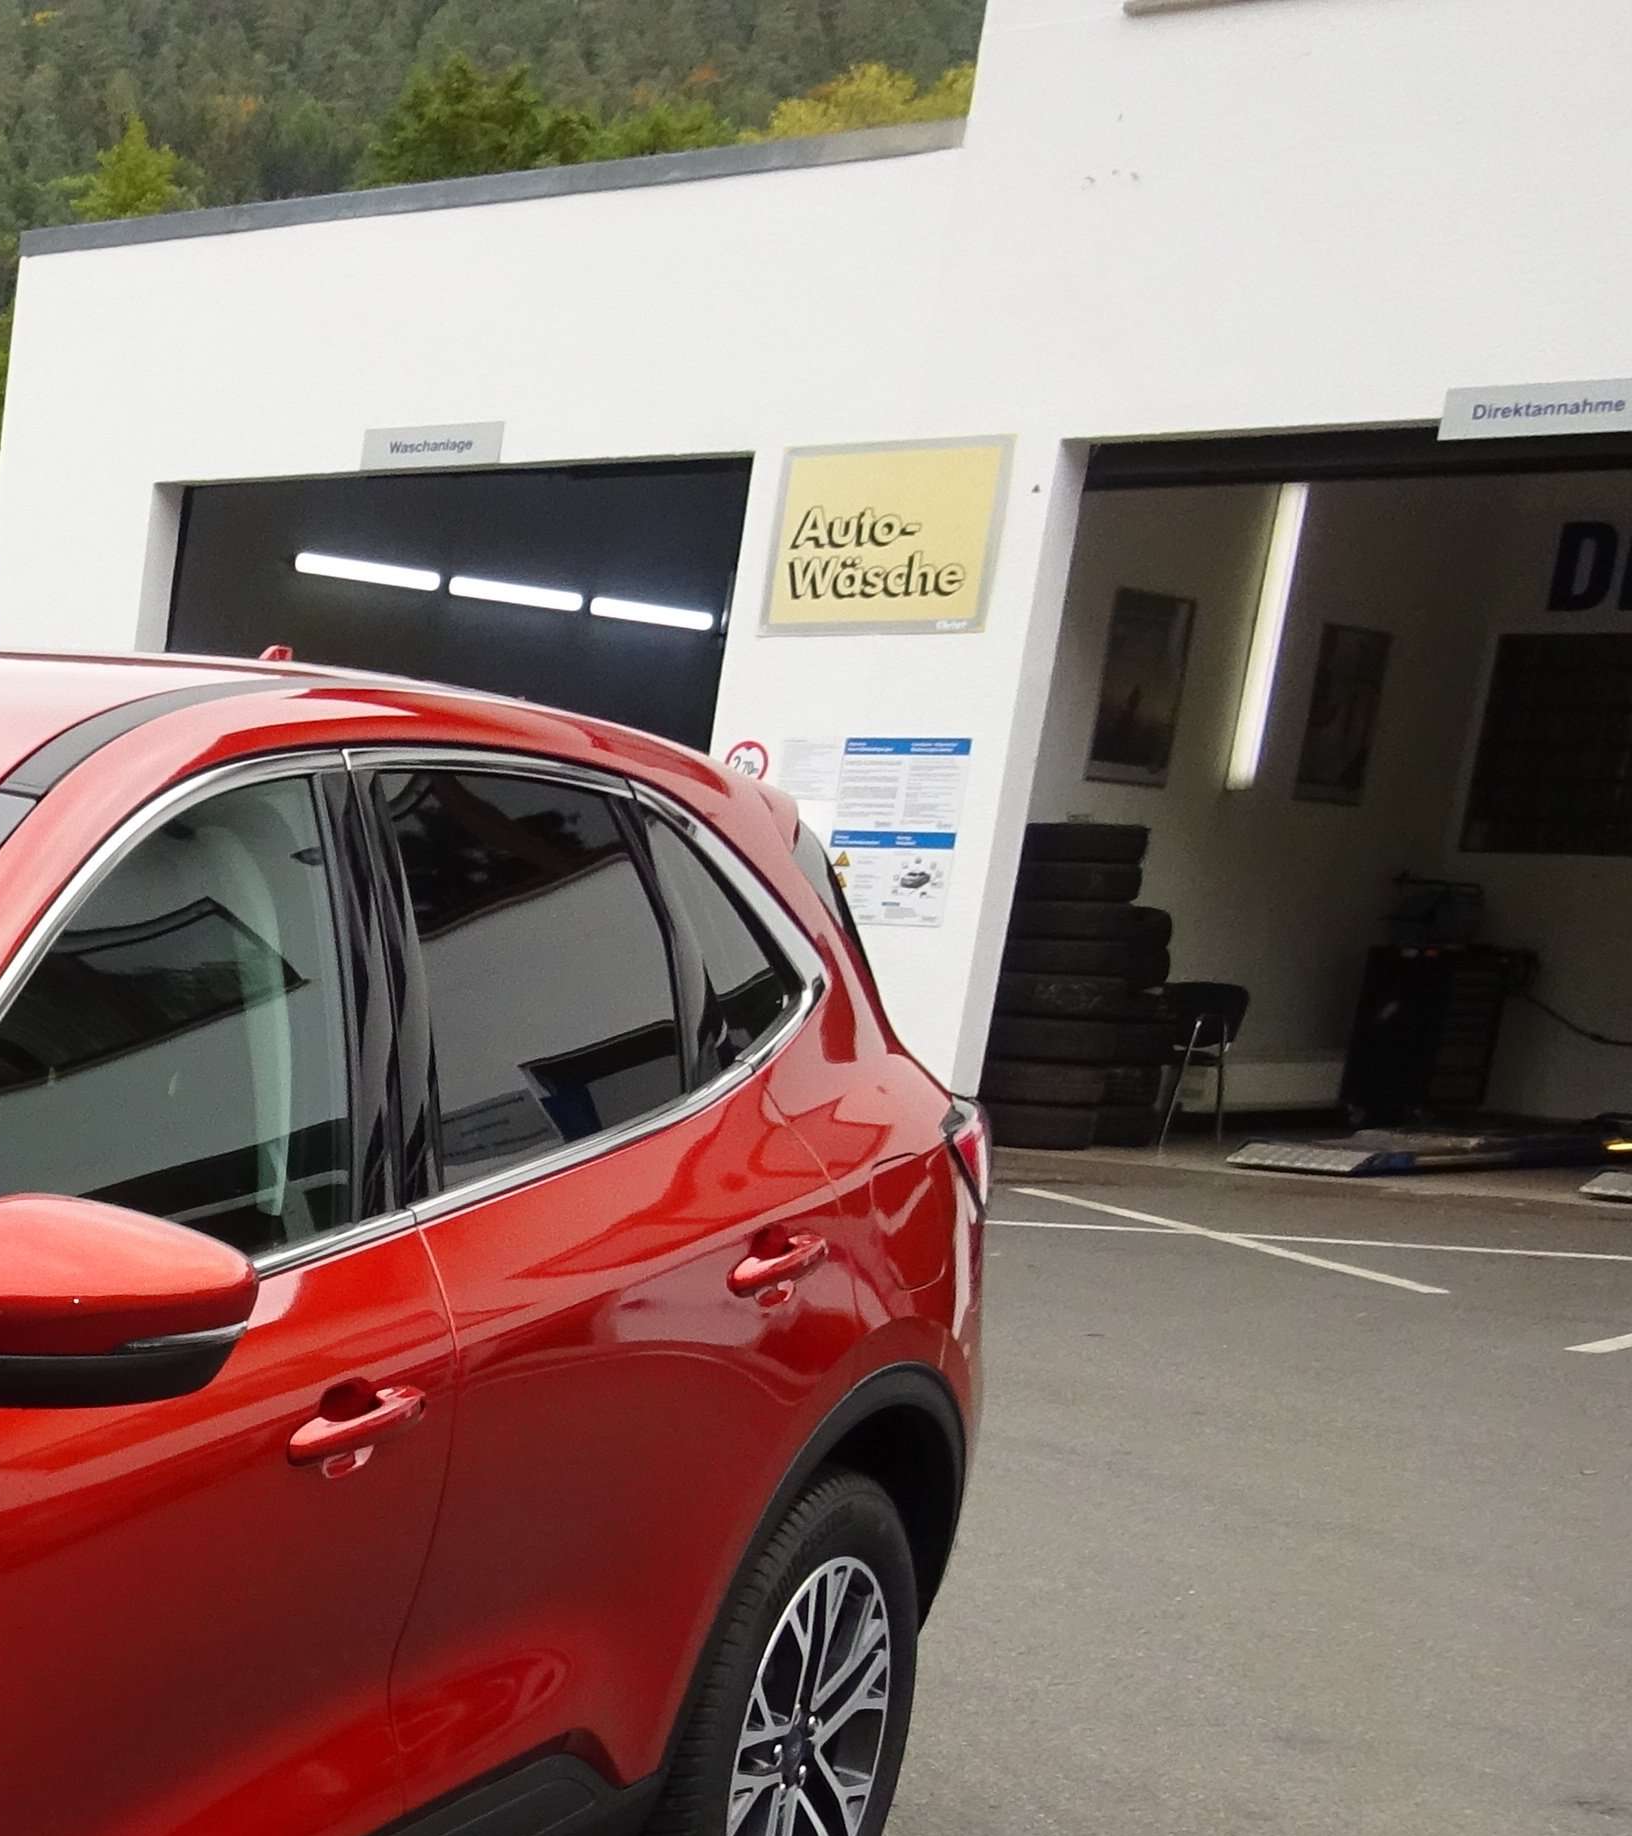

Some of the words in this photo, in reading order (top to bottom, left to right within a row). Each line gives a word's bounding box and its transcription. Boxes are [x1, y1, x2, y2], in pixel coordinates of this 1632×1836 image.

[1471, 397, 1626, 421] Direktannahme
[389, 438, 474, 454] Waschanlage
[791, 505, 922, 550] Auto-
[789, 551, 967, 599] Wäsche
[1546, 520, 1632, 612] D
